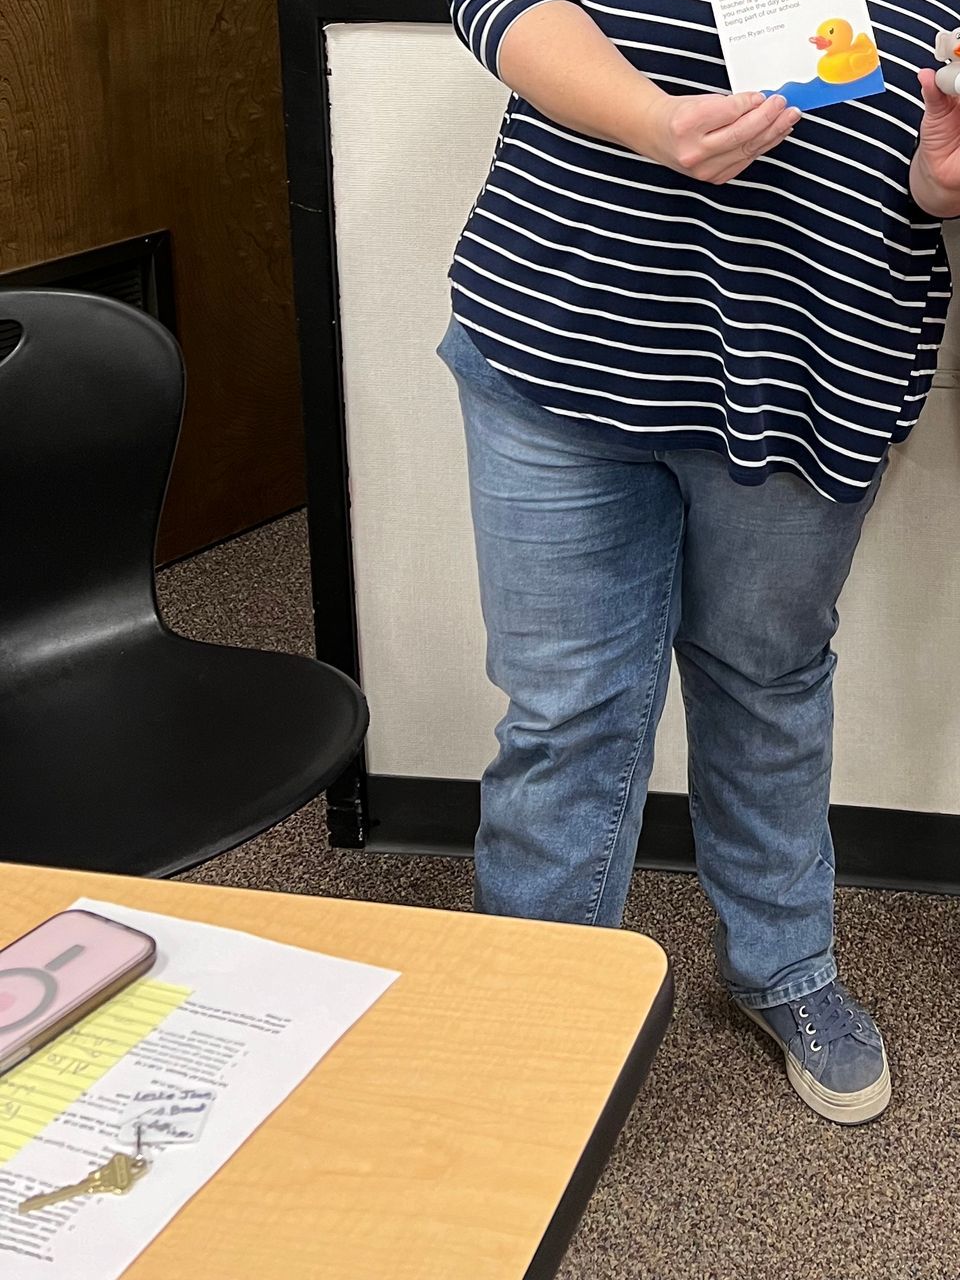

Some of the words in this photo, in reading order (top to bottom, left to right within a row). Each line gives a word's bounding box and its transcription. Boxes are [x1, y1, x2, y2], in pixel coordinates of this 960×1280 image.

[720, 0, 745, 10] teacher
[723, 10, 735, 19] you
[736, 6, 754, 14] make
[767, 0, 779, 7] day
[725, 17, 743, 26] being
[745, 14, 758, 23] part
[748, 29, 764, 38] Ryan
